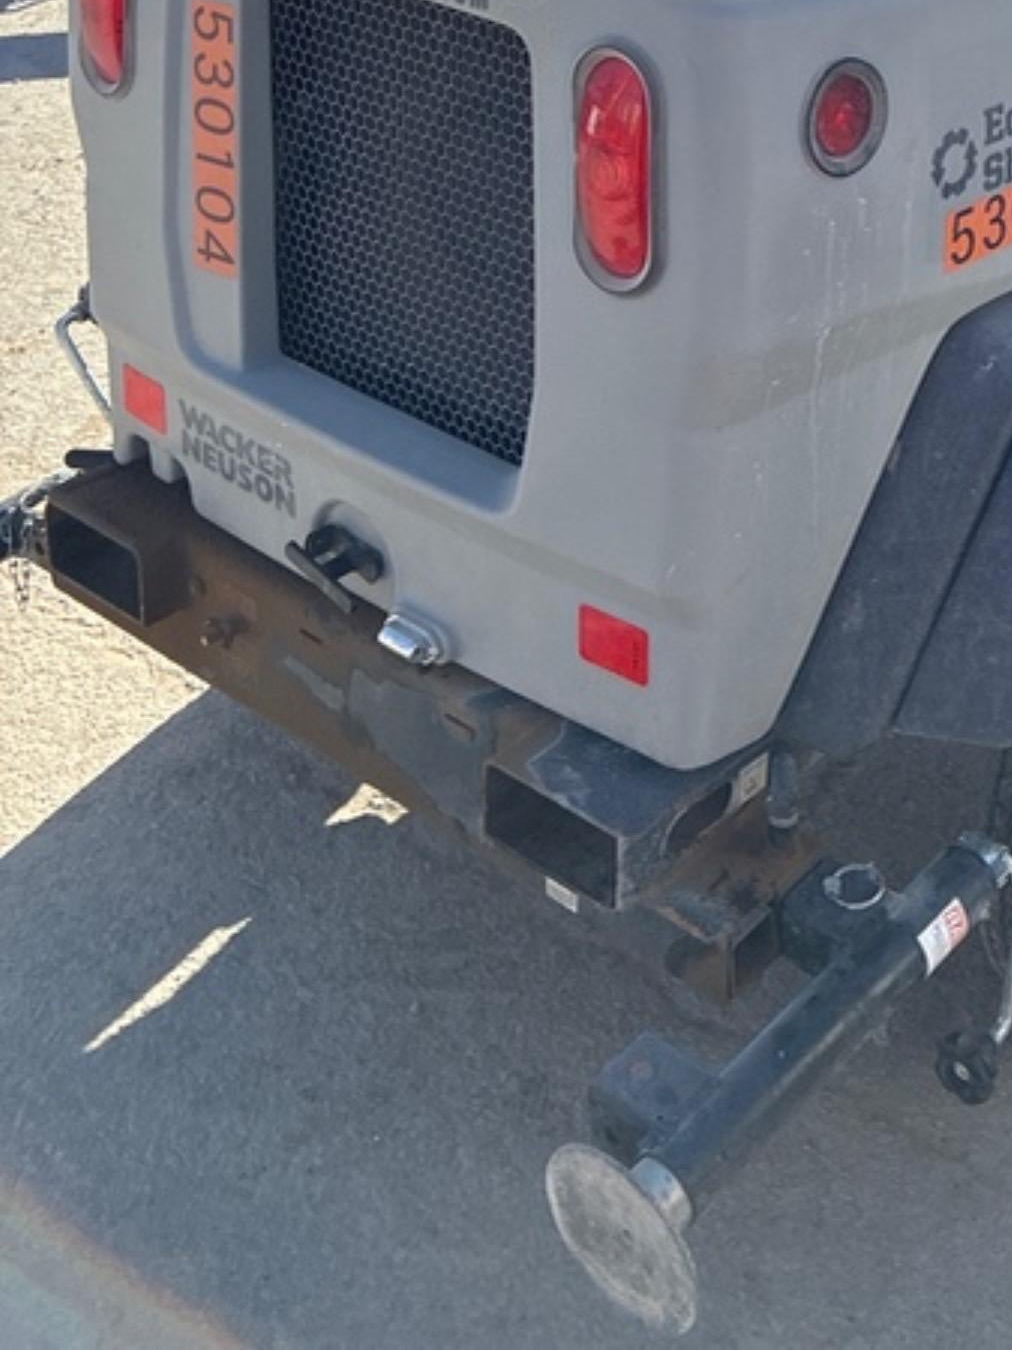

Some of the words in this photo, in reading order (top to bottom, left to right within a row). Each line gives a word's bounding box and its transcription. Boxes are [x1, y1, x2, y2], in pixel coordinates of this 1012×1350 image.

[193, 5, 236, 267] 530104
[178, 397, 295, 491] WACKER
[181, 428, 297, 520] NEUSON
